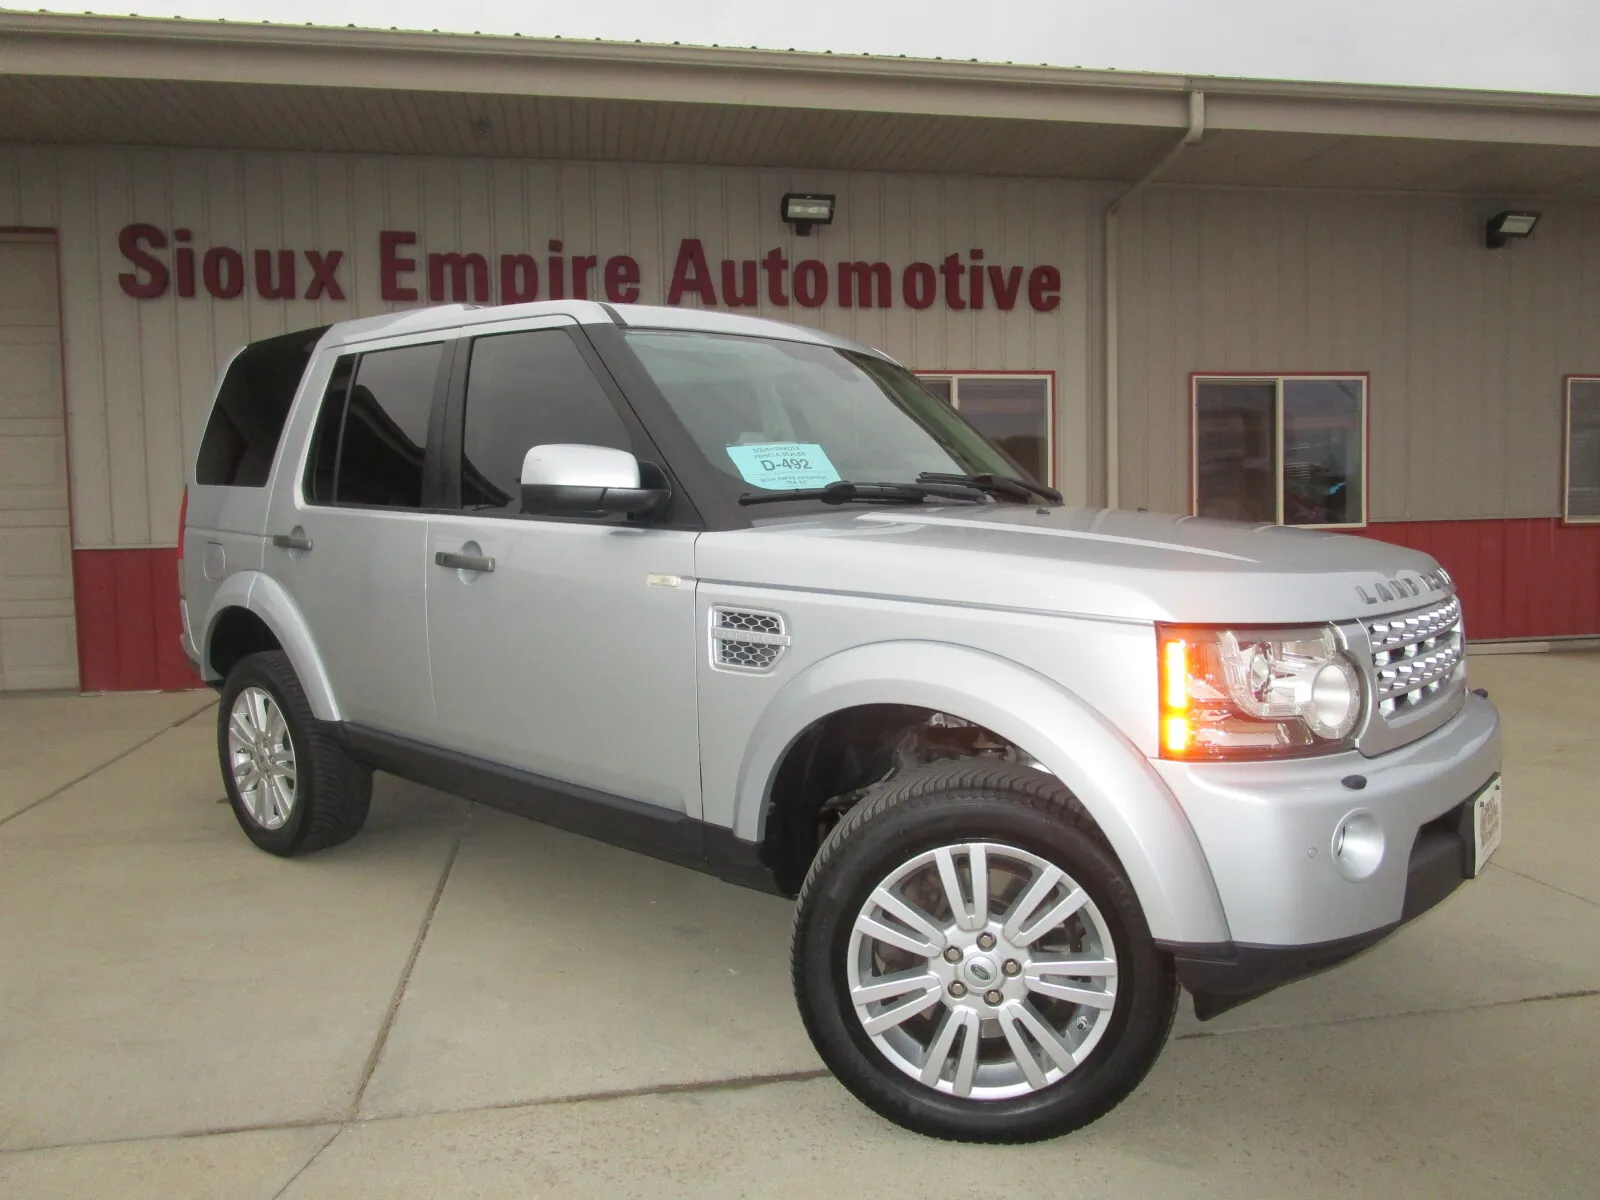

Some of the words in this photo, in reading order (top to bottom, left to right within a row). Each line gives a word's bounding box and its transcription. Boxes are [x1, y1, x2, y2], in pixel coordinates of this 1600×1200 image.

[118, 223, 345, 300] Sioux
[379, 230, 641, 305] Empire
[667, 238, 1062, 312] Automotive
[752, 446, 775, 454] SOUTH
[753, 452, 781, 460] VEHICLE
[760, 458, 812, 471] D-492
[1355, 577, 1420, 604] LAND
